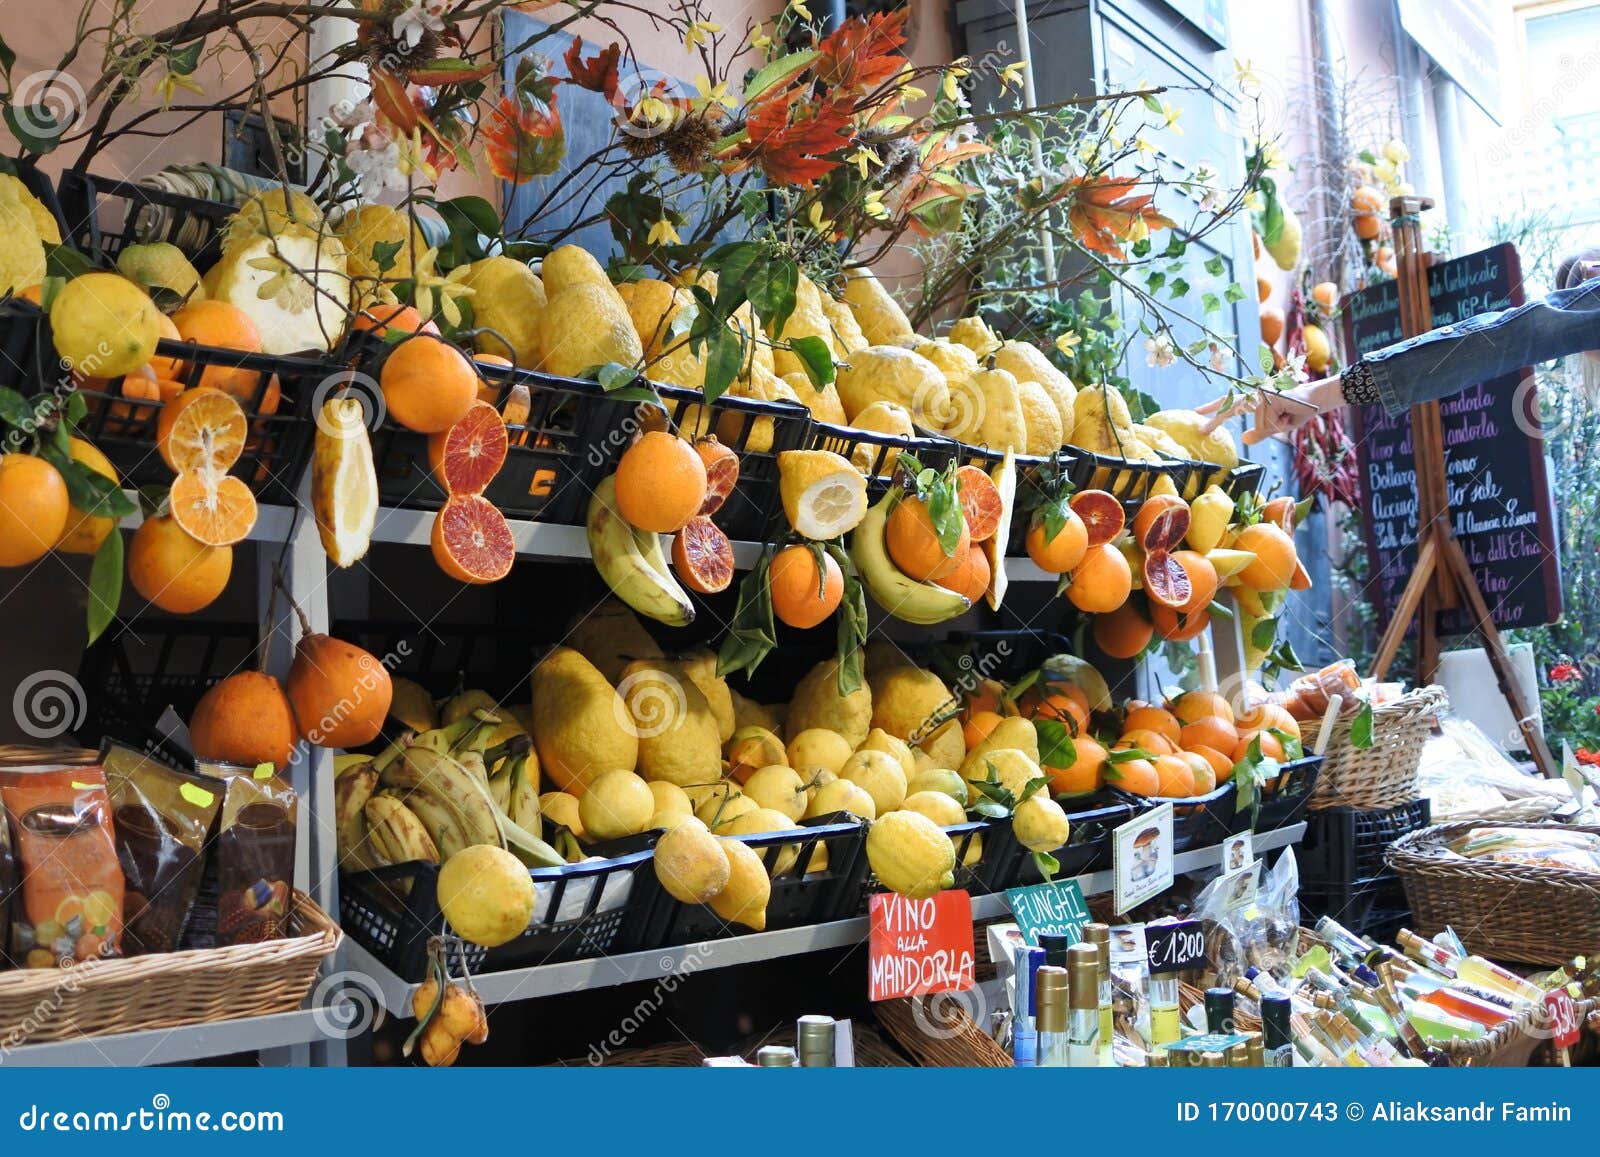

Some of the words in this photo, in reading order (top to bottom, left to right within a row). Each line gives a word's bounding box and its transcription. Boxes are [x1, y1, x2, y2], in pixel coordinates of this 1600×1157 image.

[1369, 461, 1417, 494] Bottarg
[882, 892, 936, 932] VINO
[1012, 884, 1087, 928] FUNGHI
[897, 932, 929, 952] ALLA
[871, 948, 975, 1001] MANDORLA
